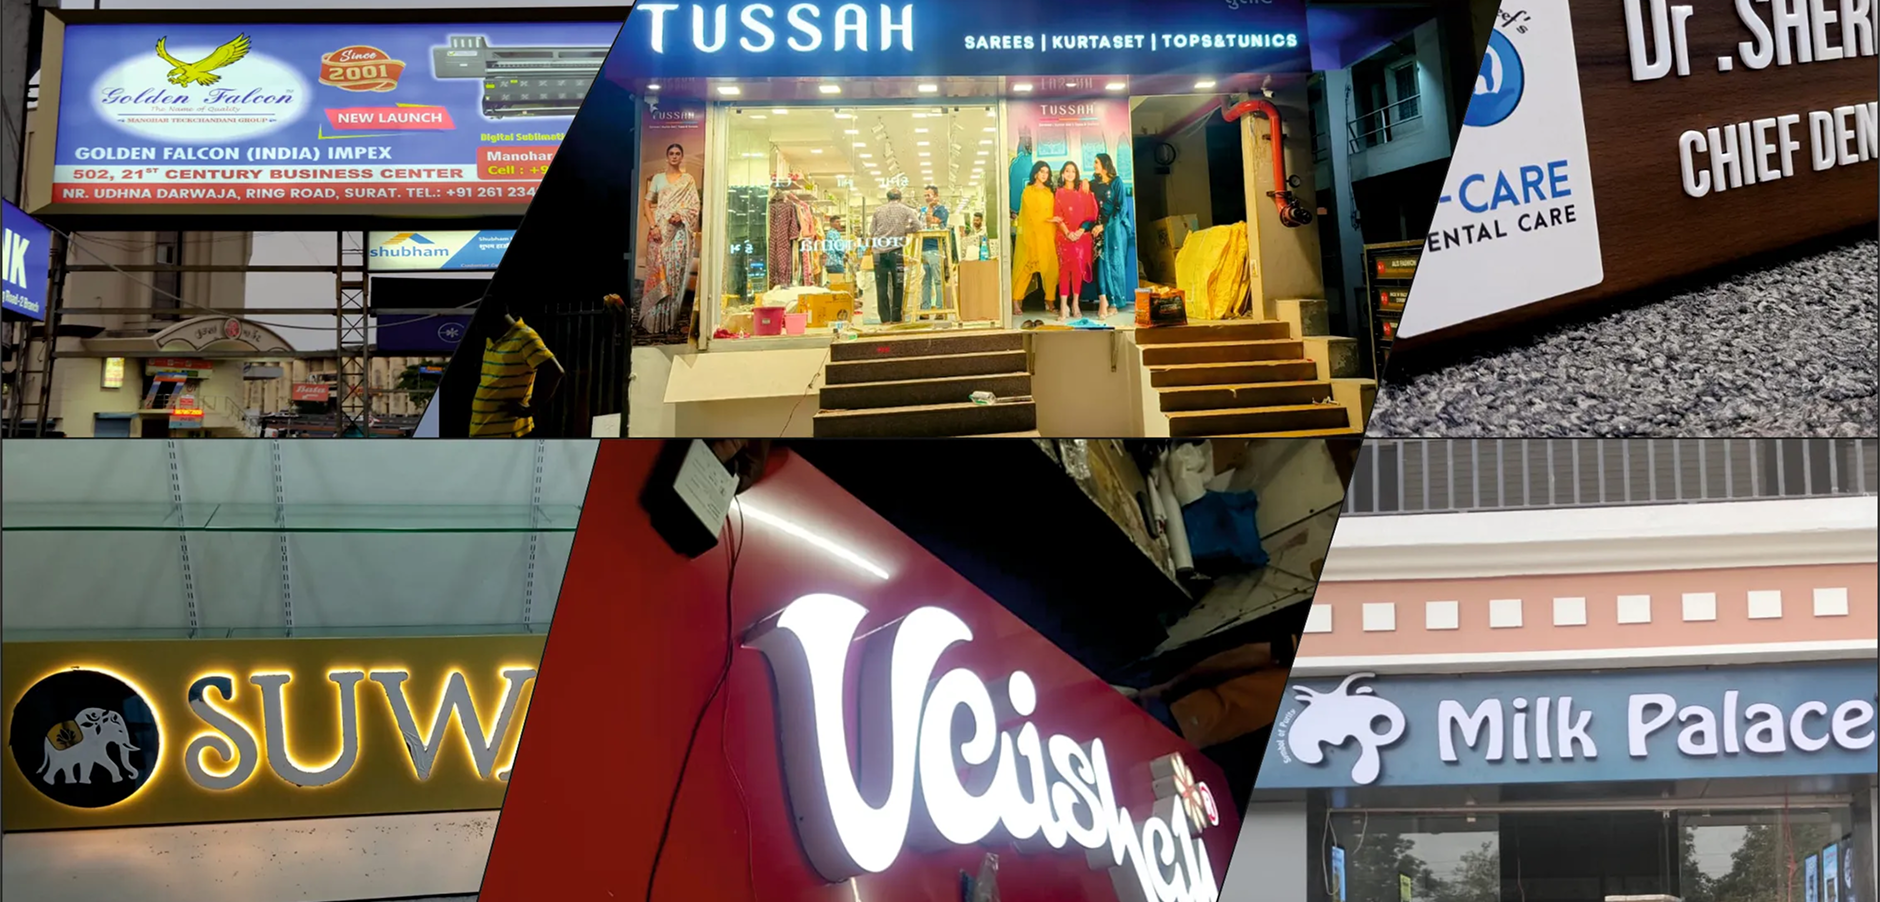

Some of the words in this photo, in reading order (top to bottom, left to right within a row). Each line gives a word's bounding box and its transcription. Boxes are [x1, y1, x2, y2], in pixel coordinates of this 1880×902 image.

[634, 1, 915, 54] TUSSAH
[964, 34, 1035, 50] SAREES
[1052, 33, 1145, 49] KURTASET
[1161, 33, 1298, 49] TOPS&TUNICS
[1623, 0, 1694, 81] Dr
[340, 49, 377, 62] Since
[328, 64, 388, 81] 2001
[101, 87, 190, 105] Golden
[203, 87, 294, 105] Falcon
[338, 113, 374, 123] NEW
[379, 112, 442, 123] LAUNCH
[1040, 104, 1094, 116] TUSSAH
[480, 133, 514, 143] Digital
[74, 147, 156, 160] GOLDEN
[163, 147, 239, 160] FALCON
[247, 147, 320, 162] (INDIA)
[328, 147, 392, 160] IMPEX
[487, 151, 554, 161] Manohar
[1678, 114, 1800, 198] CHIEF
[73, 169, 115, 182] 502,
[121, 167, 159, 180] 21ST
[165, 169, 263, 180] CENTURY
[270, 168, 373, 180] BUSINESS
[380, 168, 464, 179] CENTER
[488, 165, 515, 175] Cell
[63, 188, 89, 199] NR.
[94, 188, 152, 199] UDHNA
[156, 188, 241, 201] DARWAJA,
[246, 188, 285, 199] RING
[290, 188, 340, 200] ROAD,
[345, 188, 401, 199] SURAT.
[406, 188, 441, 198] TEL.:
[446, 187, 472, 198] +91
[477, 187, 503, 198] 261
[507, 187, 538, 197] 234
[1427, 219, 1507, 252] ENTAL
[1518, 204, 1577, 232] CARE
[370, 246, 449, 257] shubham
[1437, 696, 1599, 763] Milk
[1628, 690, 1876, 758] Palace
